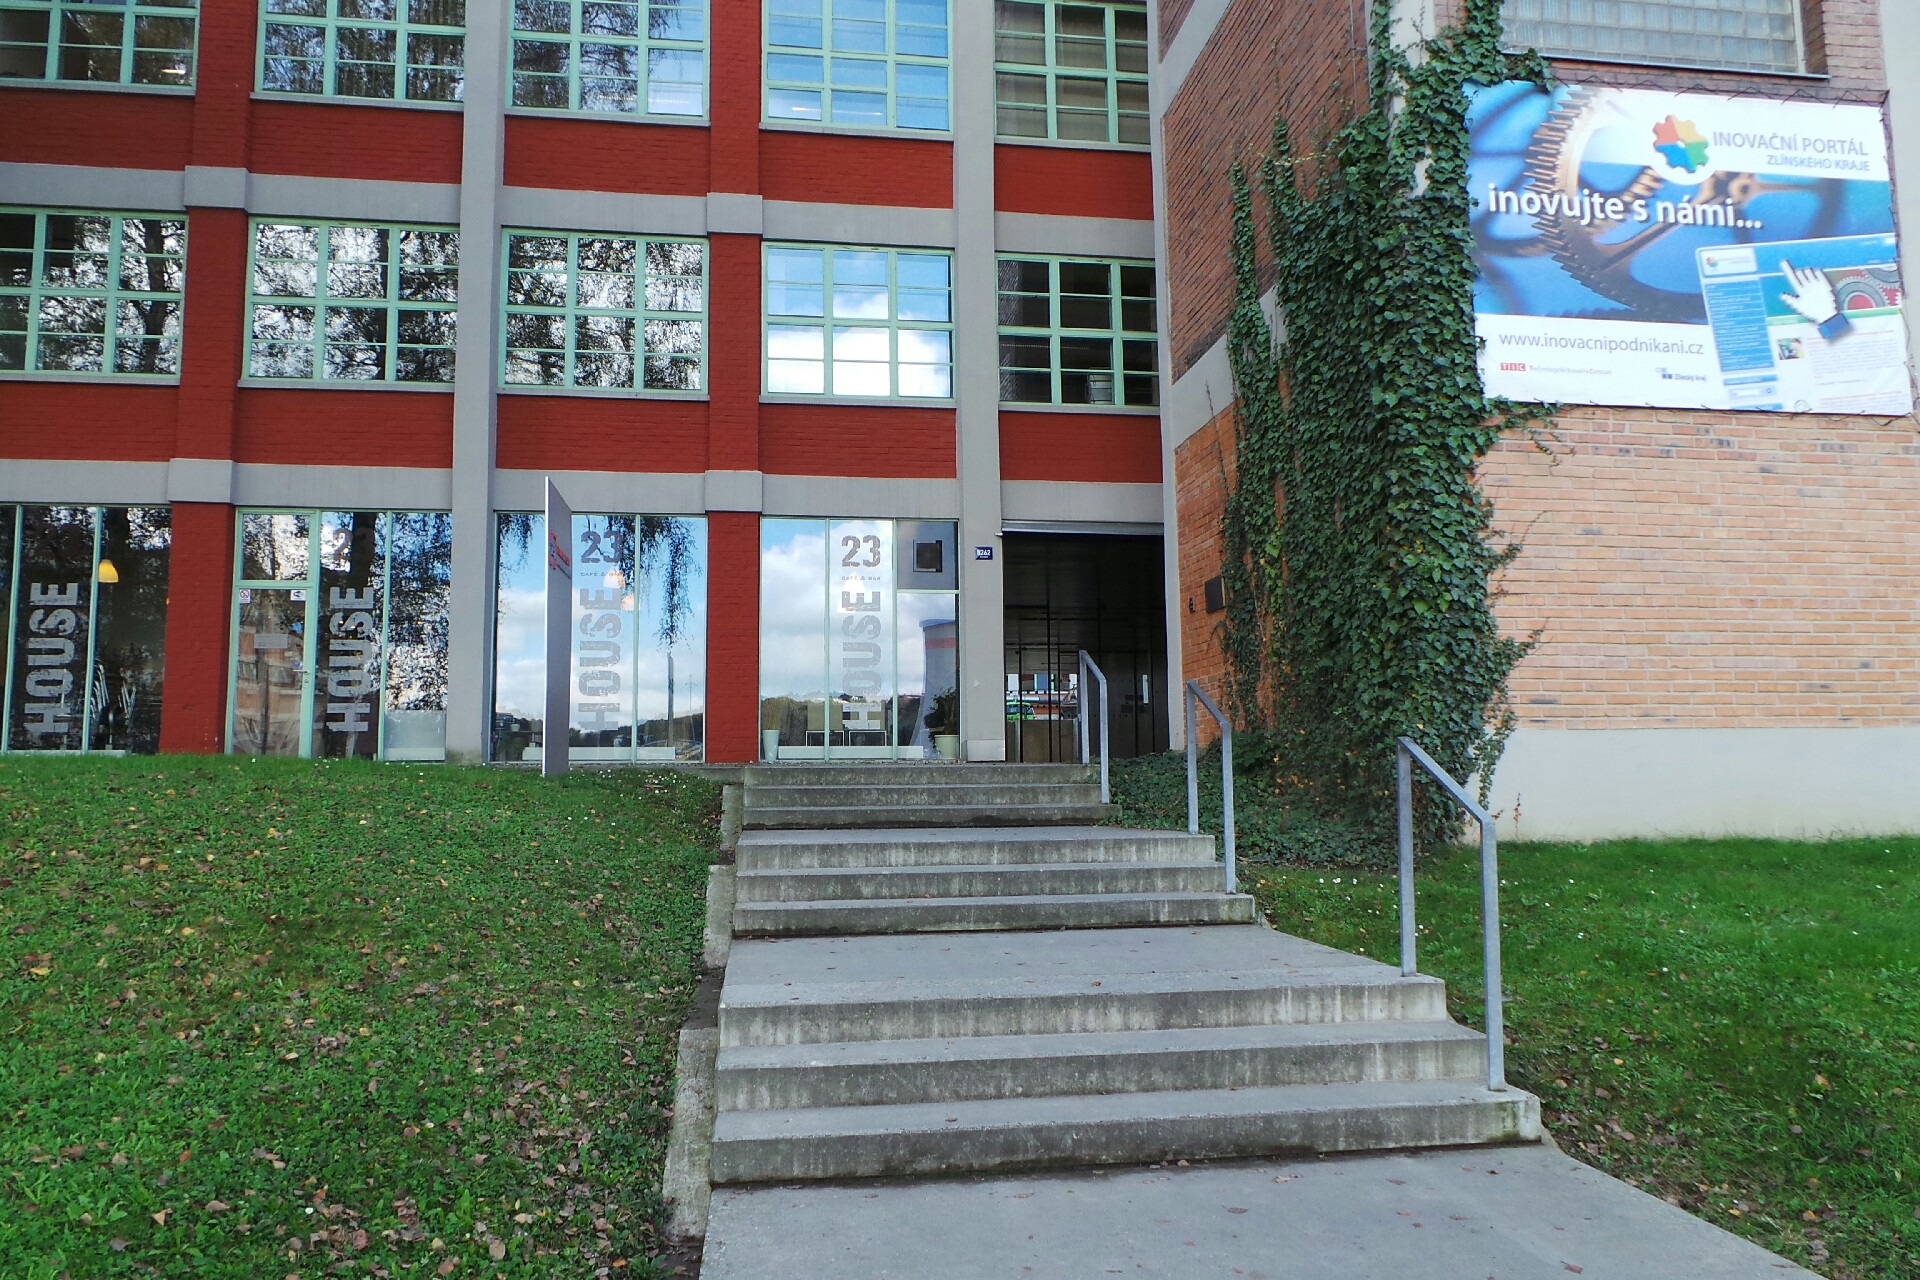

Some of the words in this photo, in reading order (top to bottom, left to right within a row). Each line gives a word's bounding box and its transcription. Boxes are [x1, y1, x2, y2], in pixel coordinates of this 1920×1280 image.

[1713, 131, 1799, 152] INOVAČNÍ
[1803, 138, 1869, 156] PORTÁL
[1767, 154, 1832, 169] ZLÍNSKÉHO
[1835, 159, 1871, 171] KRAJE
[1488, 183, 1624, 226] inovujte
[1632, 198, 1648, 221] s
[1657, 195, 1763, 229] námi...
[1499, 333, 1704, 355] www.inovacnipodnikani.cz
[581, 530, 623, 563] 23
[842, 535, 881, 567] 23
[23, 582, 79, 734] HOUSE
[326, 586, 374, 732] HOUSE
[577, 587, 622, 732] HOUSE
[841, 591, 882, 730] HOUSE
